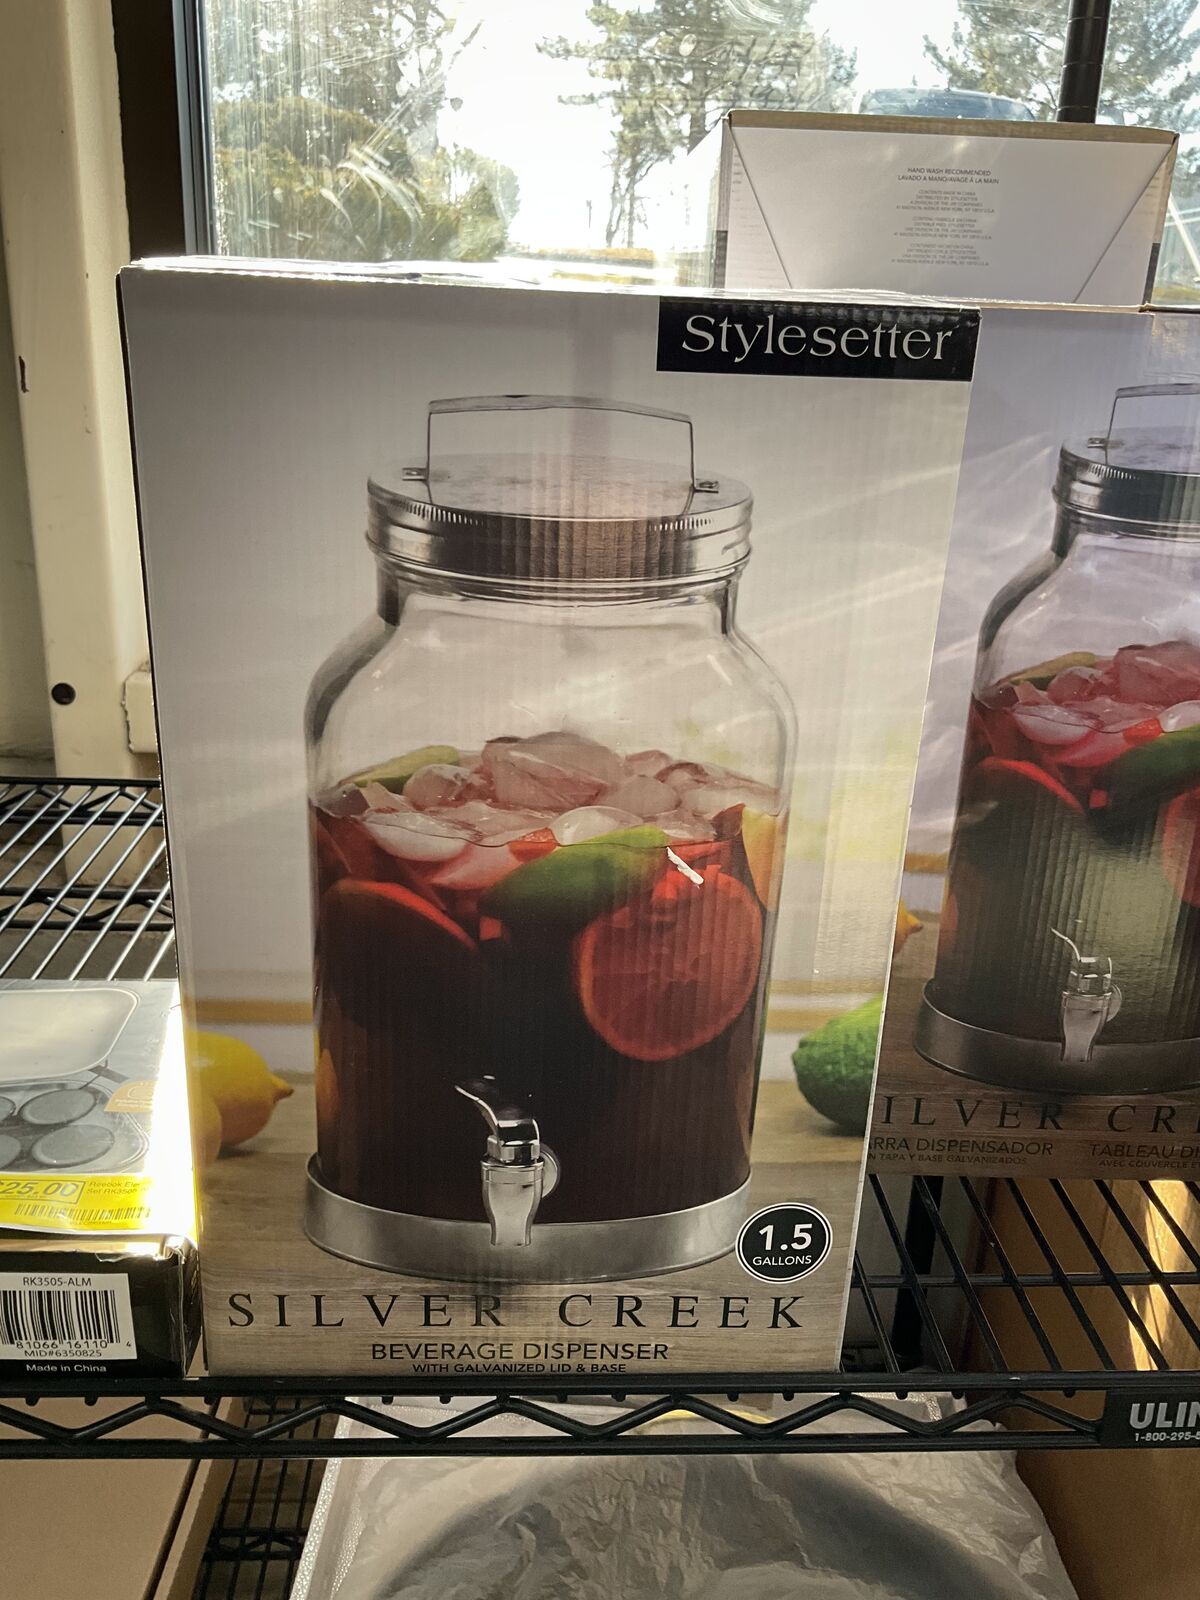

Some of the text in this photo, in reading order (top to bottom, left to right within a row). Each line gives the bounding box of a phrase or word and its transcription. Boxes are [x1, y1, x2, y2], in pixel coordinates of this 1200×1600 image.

[945, 168, 991, 176] RECOMMENDED
[682, 314, 952, 363] Stylesetter
[880, 1095, 1200, 1133] ILVER CR
[916, 1138, 1053, 1155] DISPENSADOR
[1090, 1143, 1200, 1158] TABLEAU DI
[919, 1154, 942, 1162] BASE
[946, 1155, 1027, 1165] GALVANIZADOS
[0, 1181, 79, 1197] 25.00
[759, 1223, 813, 1251] 1.5
[752, 1255, 812, 1266] GALLONS
[23, 1276, 92, 1287] RK3505-ALM
[228, 1293, 804, 1329] SILVER CREEK
[16, 1341, 58, 1349] 81066
[67, 1340, 108, 1349] 16110
[372, 1343, 669, 1360] BEVERAGE DISPENSER
[24, 1349, 102, 1357] MID#6350825
[26, 1364, 107, 1372] Made in China
[412, 1363, 626, 1373] WITH GALVANIZED LID & BASE
[1130, 1402, 1200, 1429] ULIN
